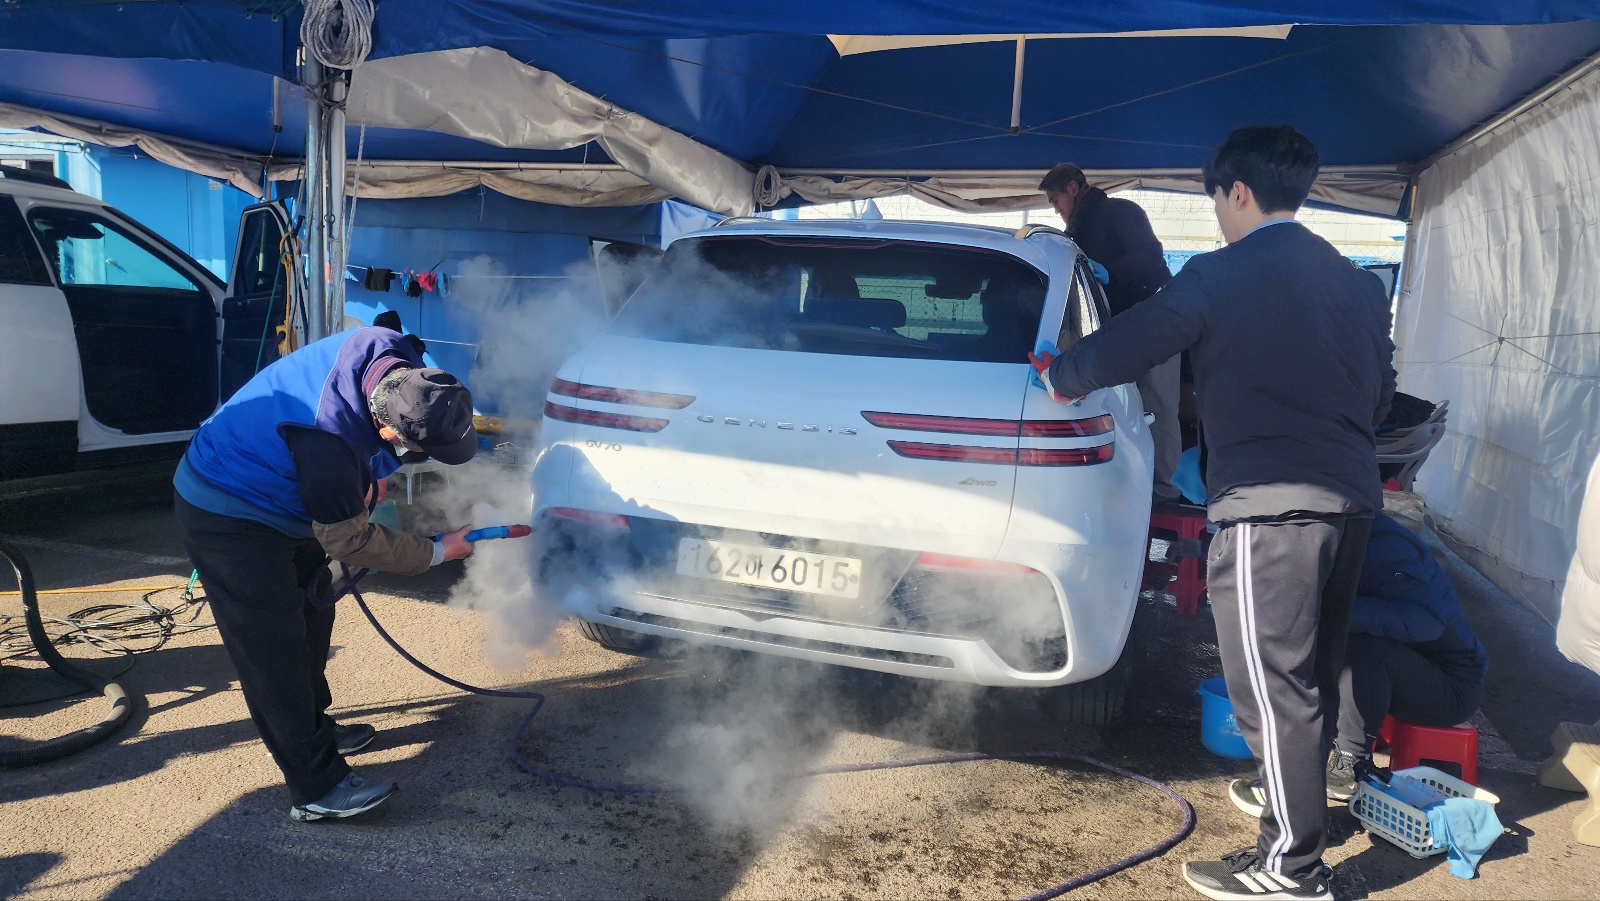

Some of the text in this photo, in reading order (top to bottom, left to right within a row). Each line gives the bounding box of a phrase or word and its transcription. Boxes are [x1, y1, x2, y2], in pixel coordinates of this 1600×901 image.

[697, 414, 857, 436] GENESIS
[585, 439, 623, 452] GV70
[770, 554, 850, 592] 6015
